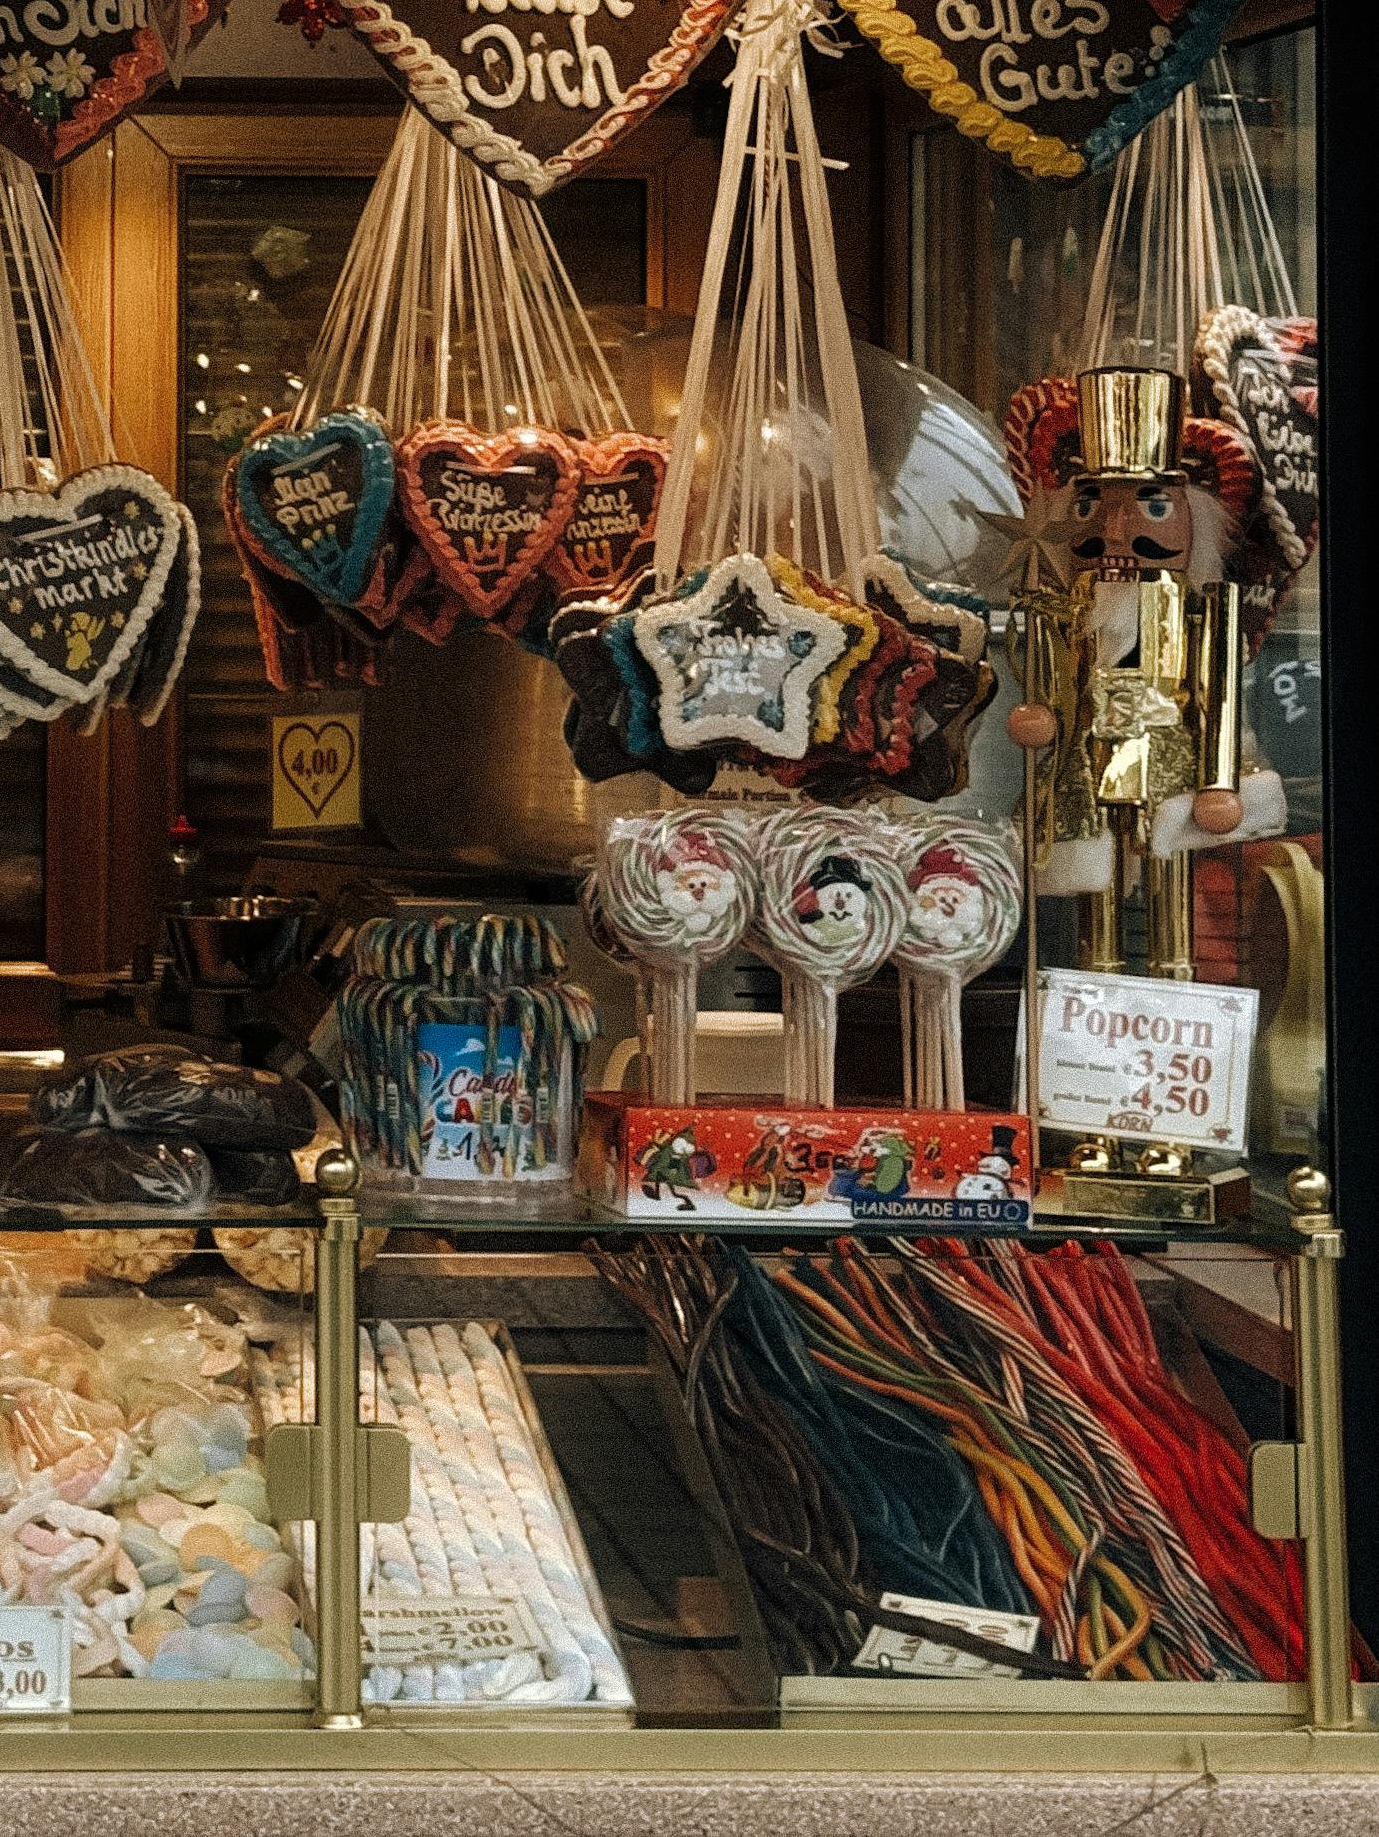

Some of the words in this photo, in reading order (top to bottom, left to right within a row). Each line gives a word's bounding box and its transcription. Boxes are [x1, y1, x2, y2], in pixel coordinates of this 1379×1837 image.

[461, 13, 629, 109] Dich
[979, 38, 1140, 111] Gute
[33, 565, 129, 610] markt
[291, 748, 338, 781] 4,00
[1058, 995, 1215, 1050] Popcorn
[852, 1201, 954, 1219] HANDMADE
[958, 1202, 973, 1218] in
[977, 1201, 1001, 1218] EU
